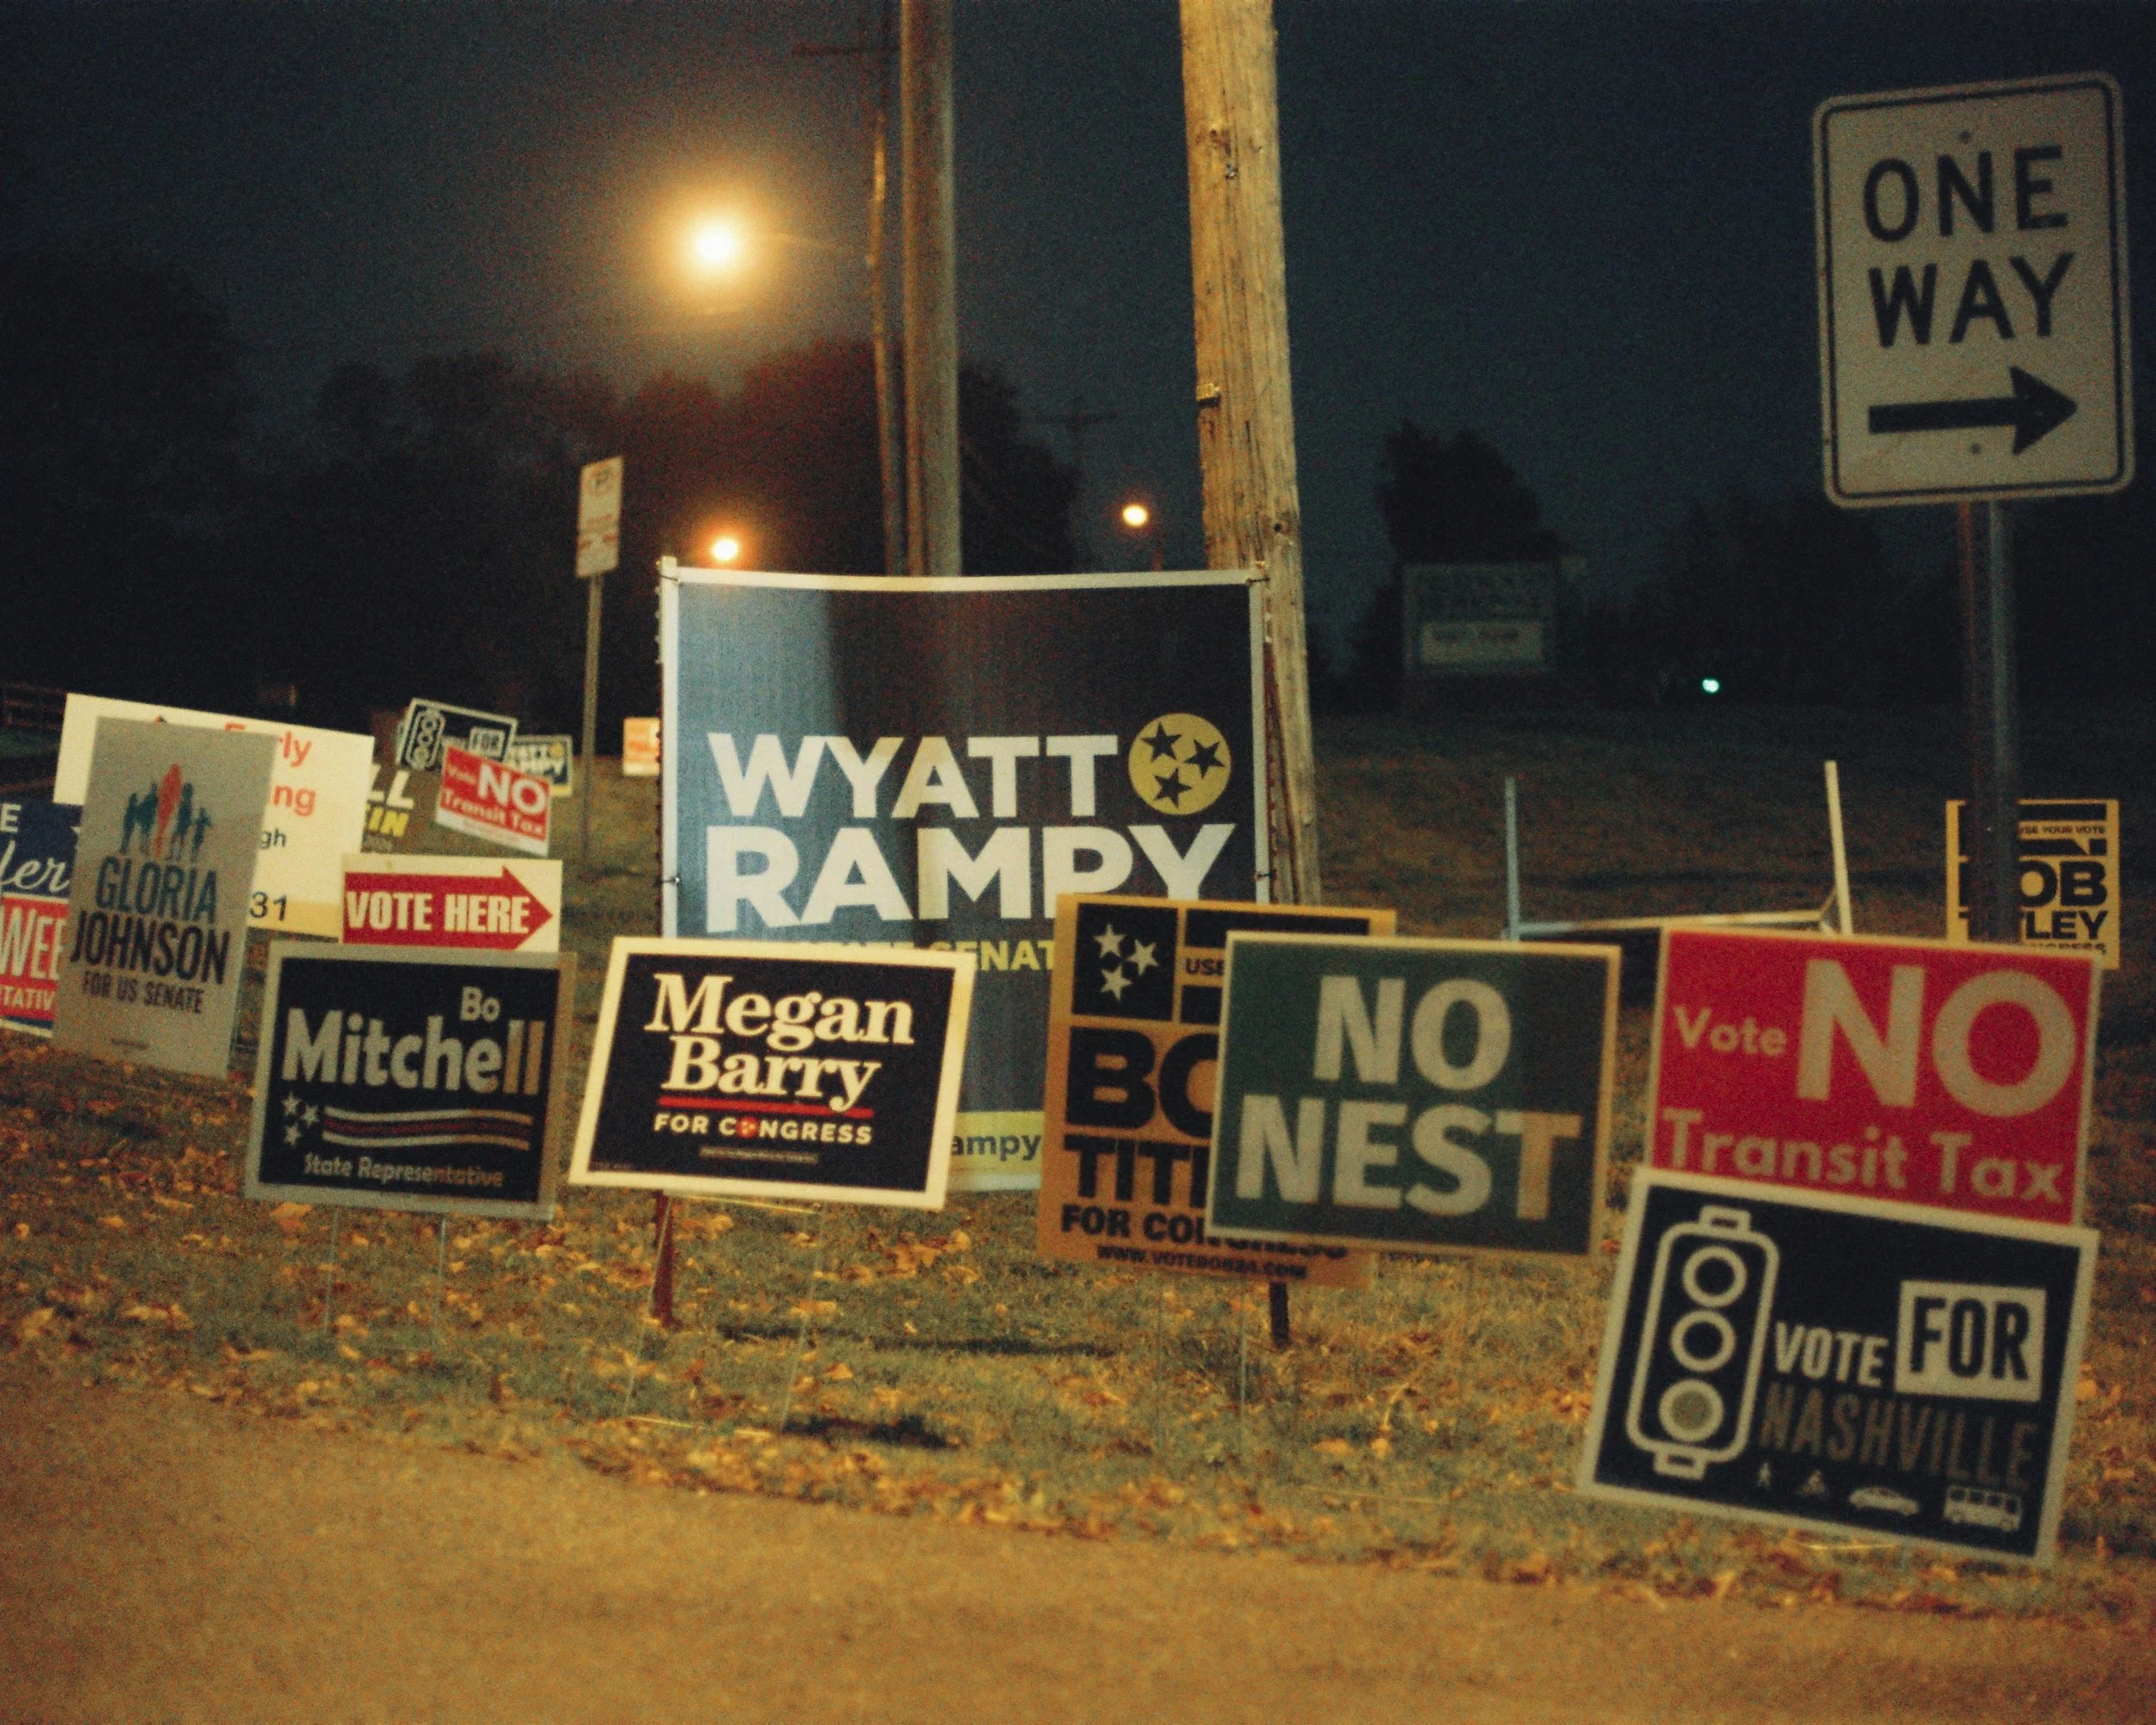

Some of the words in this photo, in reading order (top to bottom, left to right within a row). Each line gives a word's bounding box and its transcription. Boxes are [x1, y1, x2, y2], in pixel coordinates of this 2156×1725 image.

[1864, 144, 2068, 243] ONE
[1867, 253, 2074, 348] WAY
[279, 731, 312, 768] ly
[706, 731, 1119, 819] WYATT
[366, 802, 410, 837] IN
[442, 788, 506, 826] Transit
[511, 810, 544, 836] Tax
[478, 764, 547, 816] NO
[96, 856, 217, 925] GLORIA
[249, 890, 288, 922] 31
[346, 890, 433, 932] VOTE
[444, 893, 530, 935] HERE
[706, 823, 1236, 933] RAMPY
[70, 910, 231, 985] JOHNSON
[85, 969, 111, 998] FOR
[116, 975, 139, 1003] US
[143, 980, 204, 1014] SENATE
[460, 985, 501, 1022] Bo
[643, 972, 915, 1052] Megan
[281, 1007, 546, 1096] Mitchell
[1313, 975, 1513, 1091] NO
[1673, 1003, 1788, 1057] Vote
[1796, 957, 2077, 1119] NO
[661, 1034, 882, 1113] Barry
[653, 1113, 709, 1136] FOR
[718, 1115, 873, 1145] CONGRESS
[1235, 1094, 1584, 1222] NEST
[1662, 1107, 1908, 1190] Transit
[1930, 1131, 2065, 1206] Tax
[304, 1151, 353, 1177] State
[357, 1156, 505, 1188] Representative
[1062, 1203, 1131, 1239] FOR
[1773, 1320, 1890, 1388] VOTE
[1910, 1295, 2031, 1383] FOR
[1758, 1379, 2040, 1491] NASHVILLE
